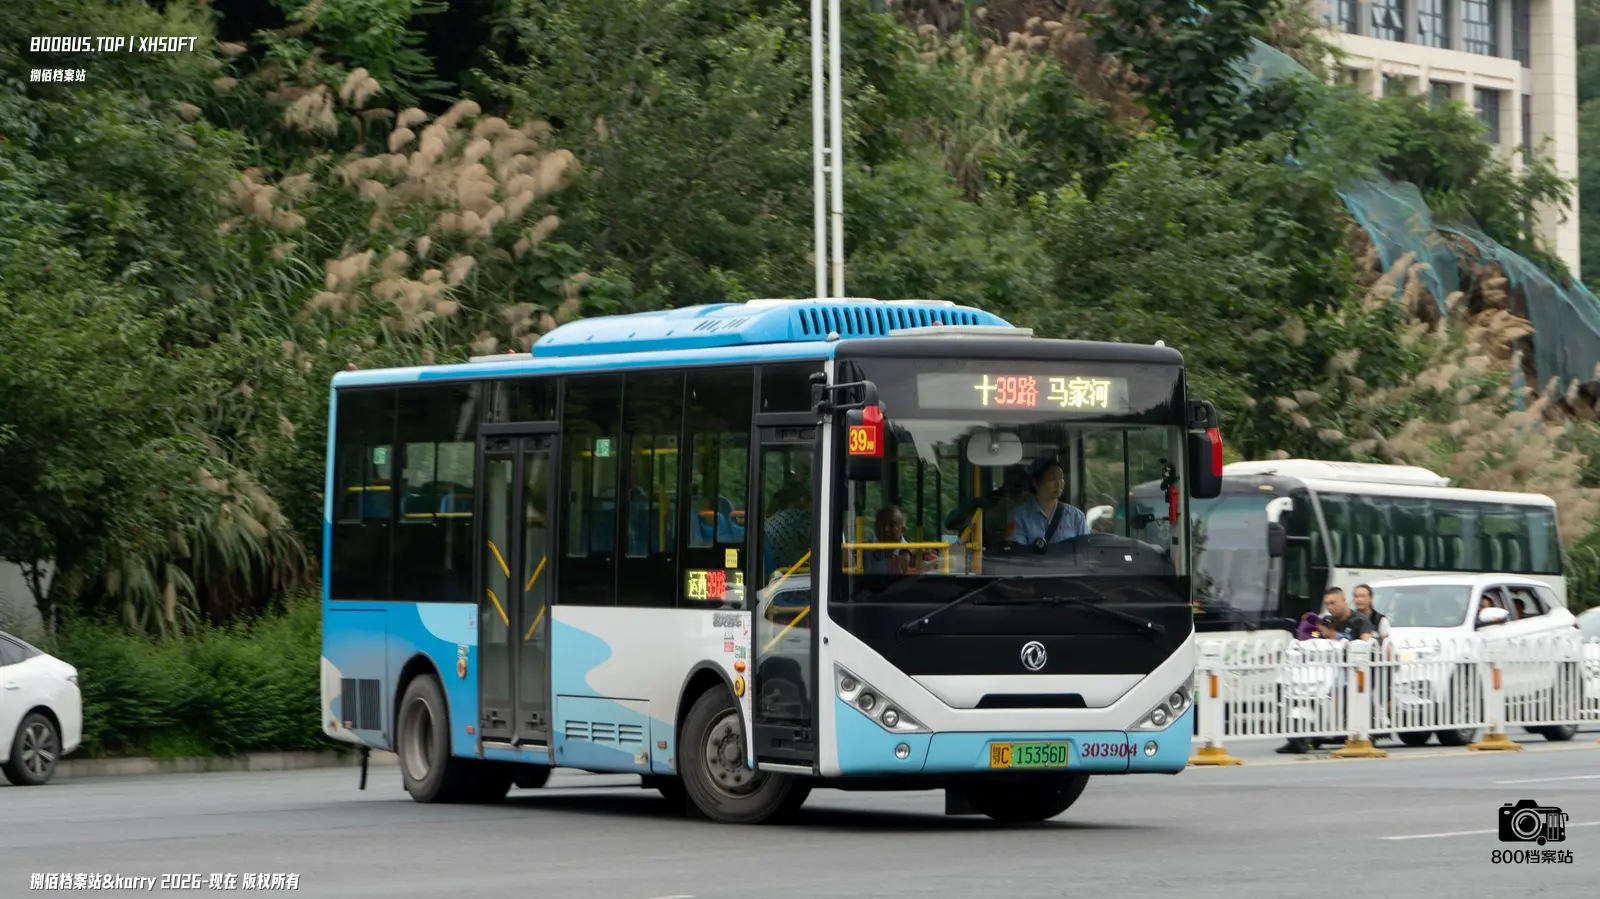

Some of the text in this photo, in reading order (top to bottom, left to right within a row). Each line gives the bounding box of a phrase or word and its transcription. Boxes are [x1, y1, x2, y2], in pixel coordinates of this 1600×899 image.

[1047, 376, 1111, 408] 马家河
[1017, 746, 1066, 764] 15356D
[1081, 742, 1137, 758] 303904
